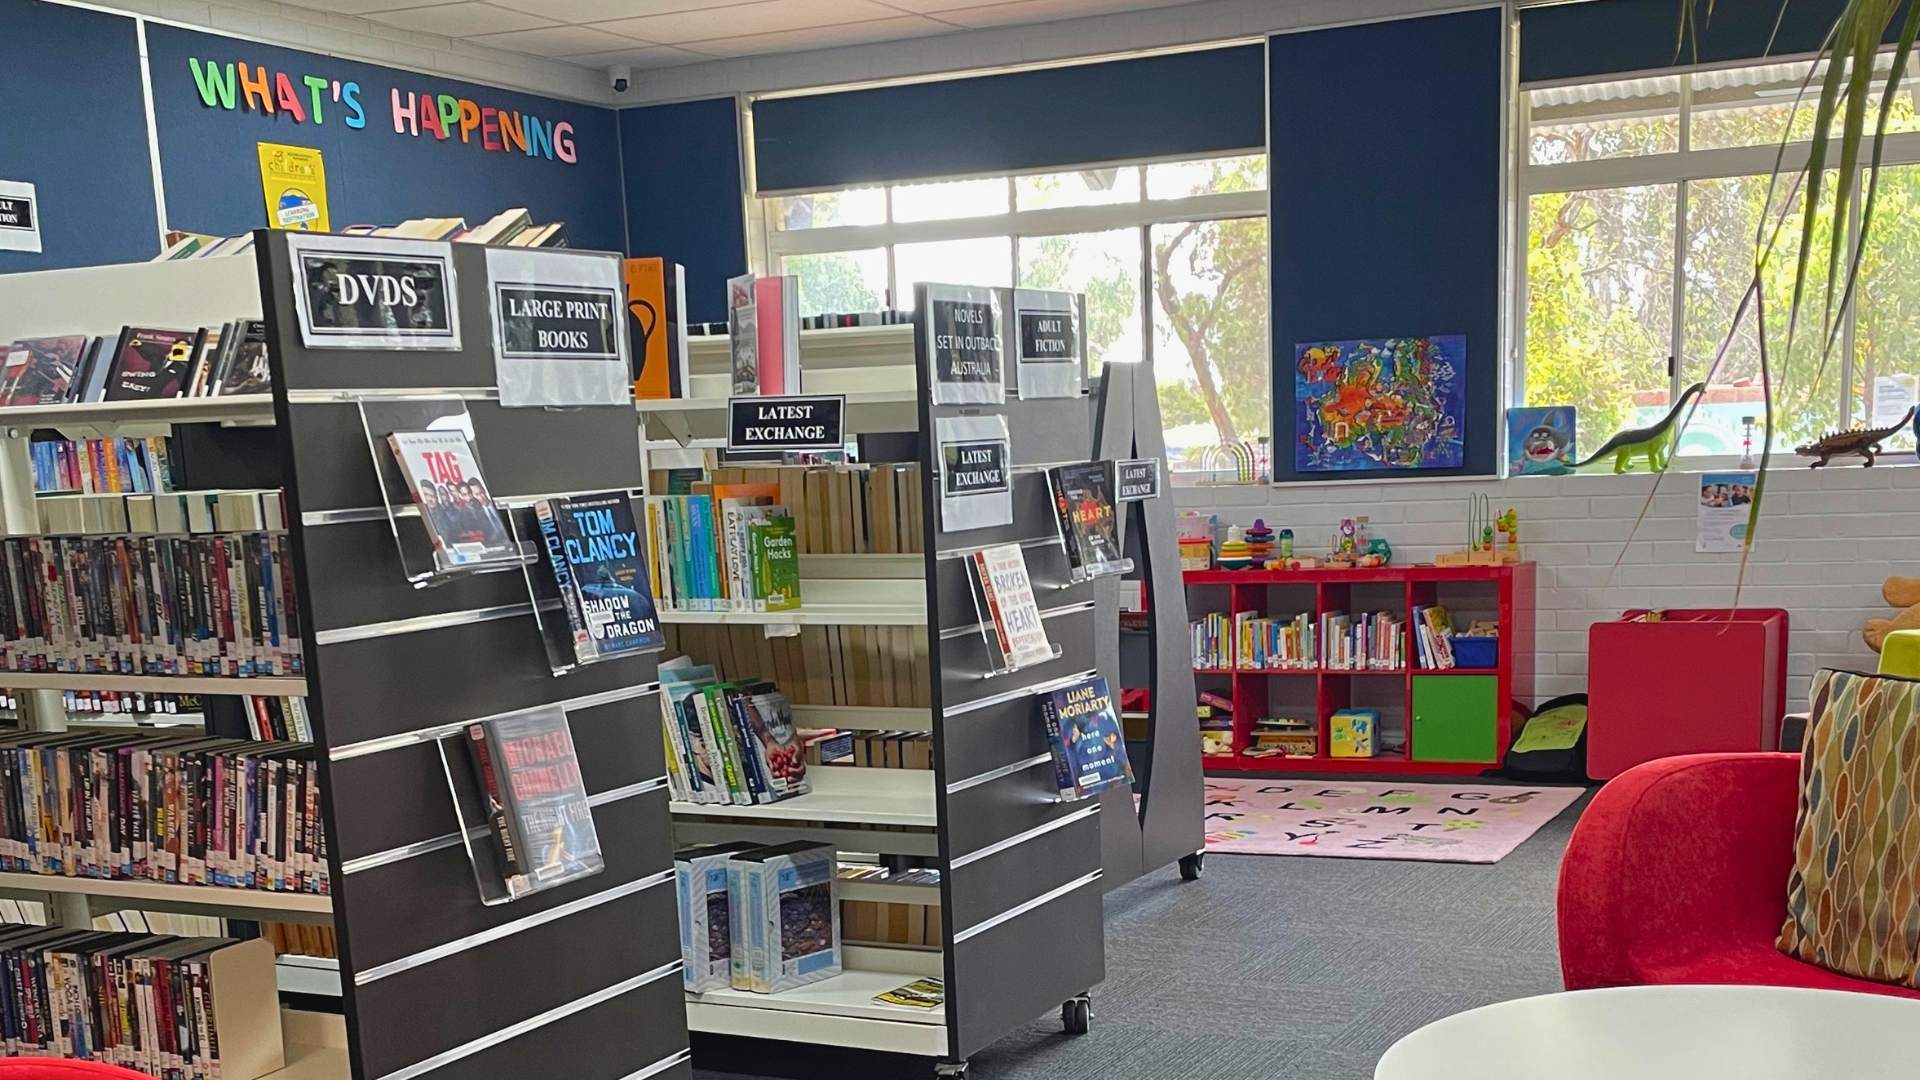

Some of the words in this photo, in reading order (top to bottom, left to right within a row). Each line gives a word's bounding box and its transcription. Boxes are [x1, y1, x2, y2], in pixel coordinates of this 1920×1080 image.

[189, 57, 365, 129] WHAT'S
[391, 87, 577, 163] HAPPENING
[283, 212, 315, 223] DESTINATION
[285, 207, 309, 216] LEARNING
[336, 274, 418, 307] DVDS
[509, 298, 563, 318] LARGE
[566, 302, 608, 319] PRINT
[955, 309, 982, 323] NOVELS
[1037, 321, 1061, 332] ADULT
[538, 330, 588, 349] BOOKS
[937, 335, 953, 349] SET
[956, 336, 964, 349] IN
[1035, 340, 1066, 352] FICTION
[951, 361, 991, 375] AUSTRALIA
[758, 406, 813, 419] LATEST
[745, 426, 824, 440] EXCHANGE
[961, 450, 991, 464] LATEST
[422, 451, 463, 484] TAG
[1126, 468, 1146, 479] LATEST
[956, 470, 1000, 486] EXCHANGE
[1123, 484, 1151, 495] EXCHANGE
[573, 509, 615, 536] TOM
[1073, 506, 1111, 523] HEART
[566, 532, 636, 564] CLANCY
[764, 536, 792, 547] Garden
[548, 536, 572, 589] CLANCY
[767, 549, 791, 559] Hacks
[732, 557, 740, 582] LOVE
[994, 572, 1028, 593] BROKEN
[154, 593, 164, 620] SPY
[585, 595, 629, 614] SHADOW
[615, 611, 631, 620] THE
[1004, 605, 1038, 634] HEART
[606, 618, 655, 638] DRAGON
[1067, 687, 1095, 703] LIANE
[1047, 701, 1055, 719] here
[1059, 696, 1108, 719] MORIARTY
[292, 703, 306, 742] ROBERTA
[700, 706, 713, 741] Bradman
[1042, 705, 1054, 736] moment
[1081, 730, 1100, 740] here
[502, 730, 574, 769] MICHAEL
[1087, 746, 1102, 754] one
[1082, 755, 1115, 771] moment
[84, 778, 90, 790] UP
[512, 760, 579, 800] CONNELLY
[84, 791, 91, 799] IN
[1451, 792, 1491, 800] G
[1361, 806, 1411, 815] M
[1437, 807, 1479, 815] N
[156, 808, 164, 836] VILLAIN
[167, 804, 175, 839] WALKER
[305, 812, 314, 848] CREEK
[497, 816, 506, 828] THE
[1299, 819, 1335, 828] S
[1407, 823, 1442, 831] T
[237, 822, 245, 849] Vegas
[500, 828, 511, 846] NIGHT
[505, 848, 516, 861] FIRE
[14, 967, 22, 990] COAST
[64, 977, 72, 1005] YOGA
